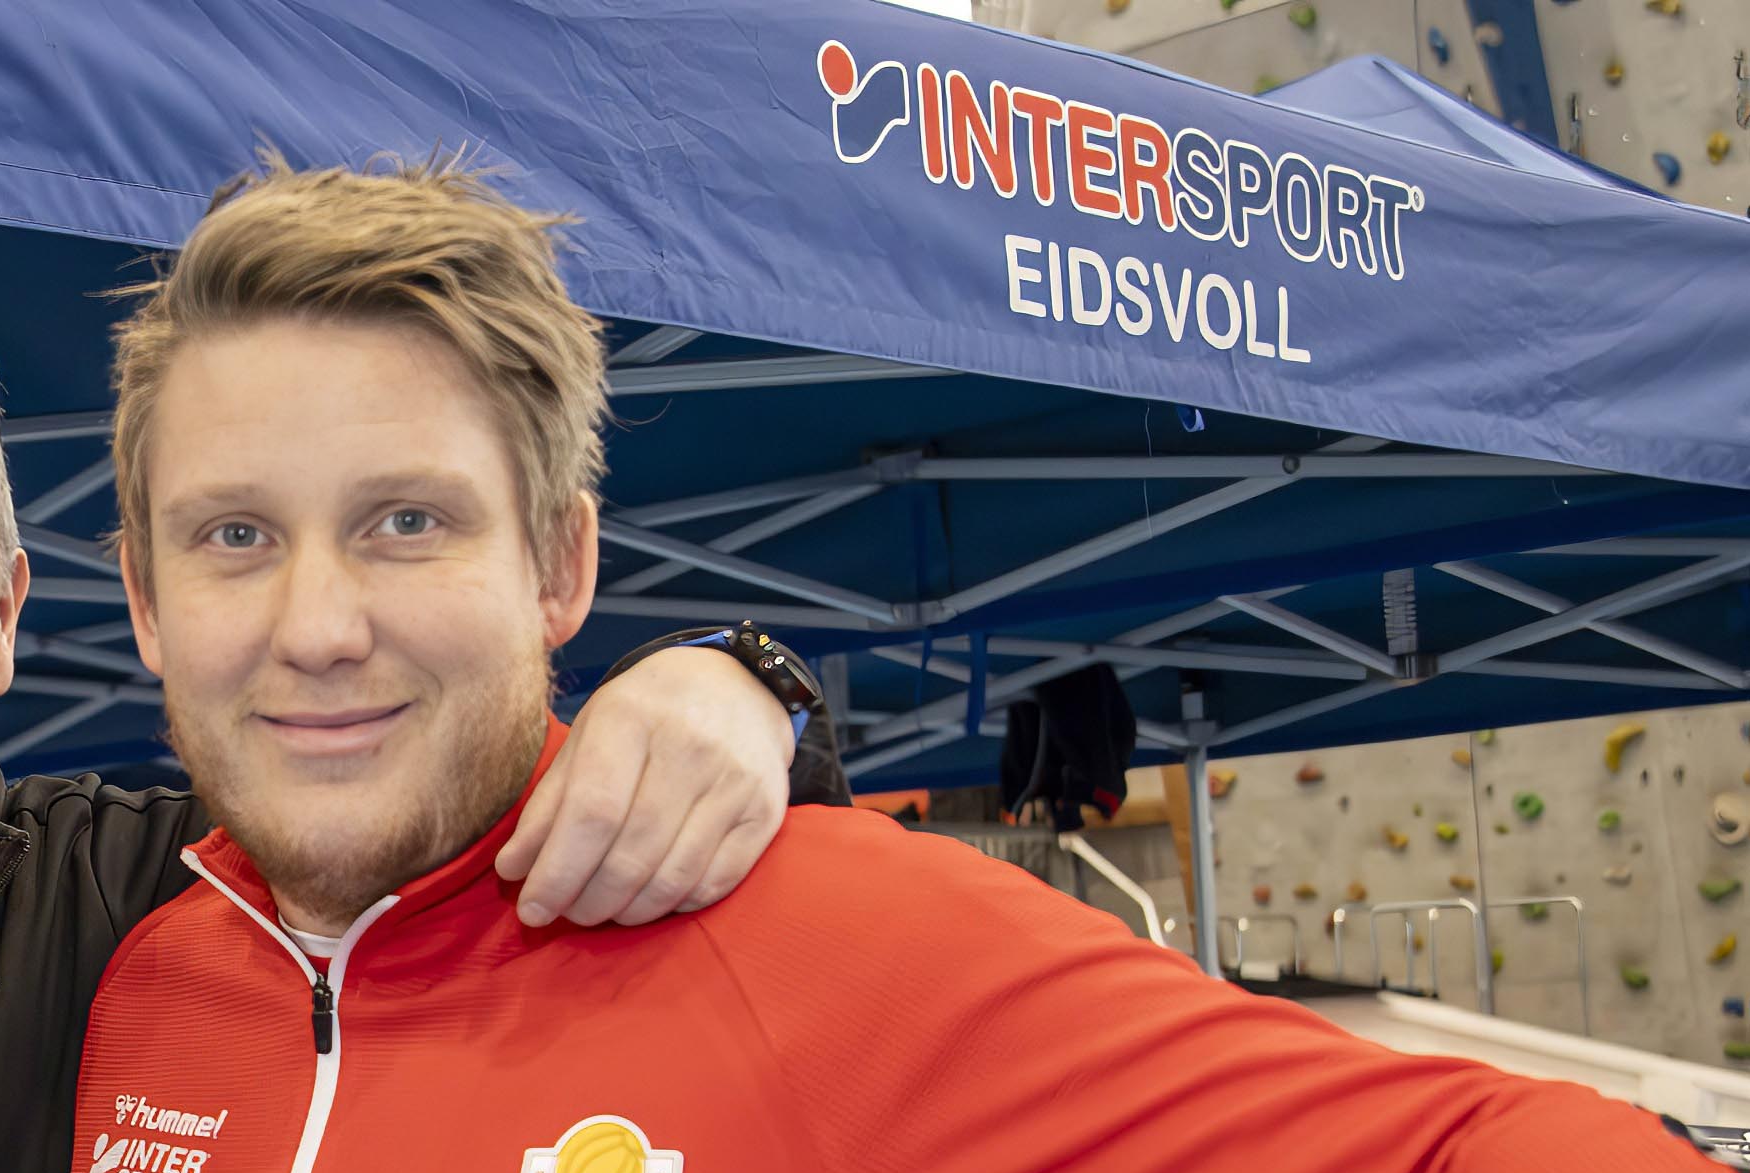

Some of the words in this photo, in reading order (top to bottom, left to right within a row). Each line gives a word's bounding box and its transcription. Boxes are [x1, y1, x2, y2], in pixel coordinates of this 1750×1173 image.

[916, 61, 1413, 281] INTERSPORT
[1004, 233, 1312, 364] EIDSVOLL
[130, 1096, 228, 1140] hummel
